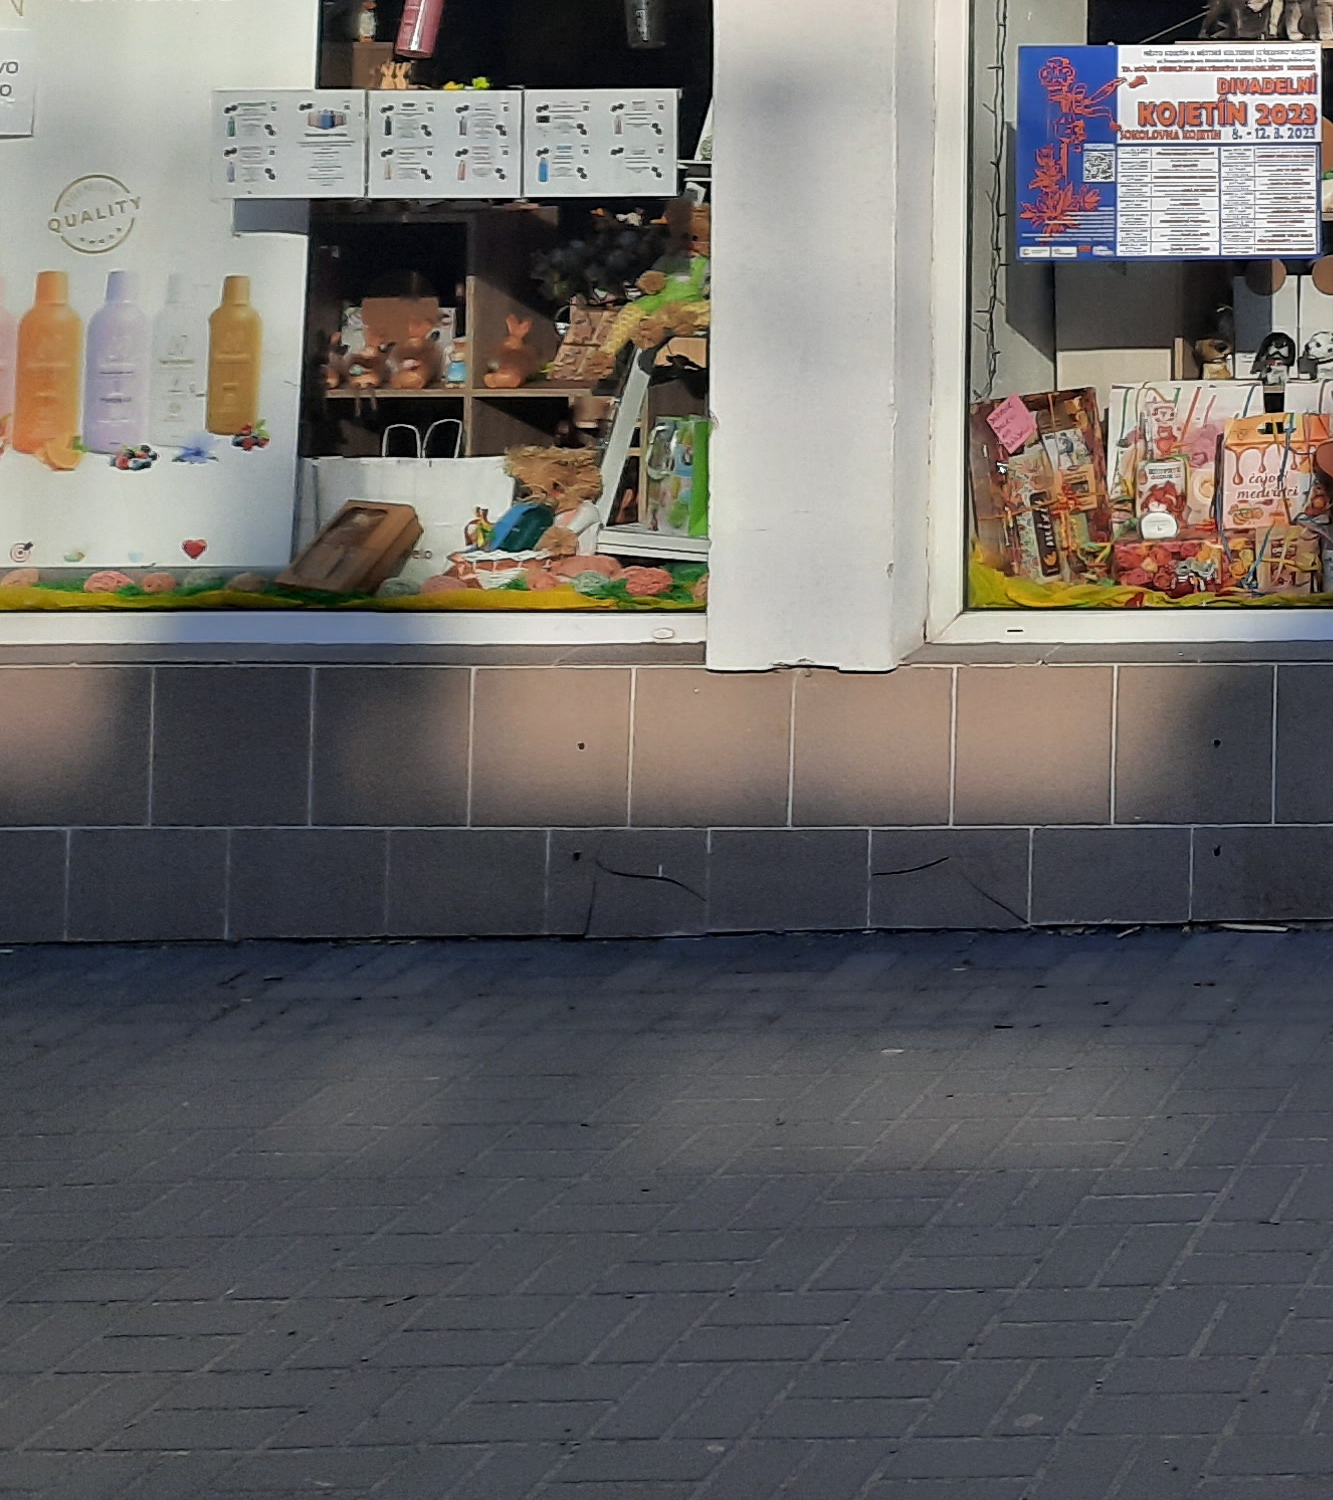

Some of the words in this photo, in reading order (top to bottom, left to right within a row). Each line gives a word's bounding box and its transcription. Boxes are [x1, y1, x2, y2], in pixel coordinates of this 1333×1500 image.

[1217, 73, 1319, 95] DIVADELNÍ
[1138, 96, 1248, 128] KOJETÍN
[1255, 103, 1317, 126] 2023
[1120, 129, 1180, 140] SOKOLOVNA
[1183, 128, 1221, 140] KOJETÍN
[1256, 128, 1271, 139] 12.
[1287, 128, 1316, 139] 2023
[48, 196, 141, 233] QUALITY
[1248, 471, 1288, 486] čajoí
